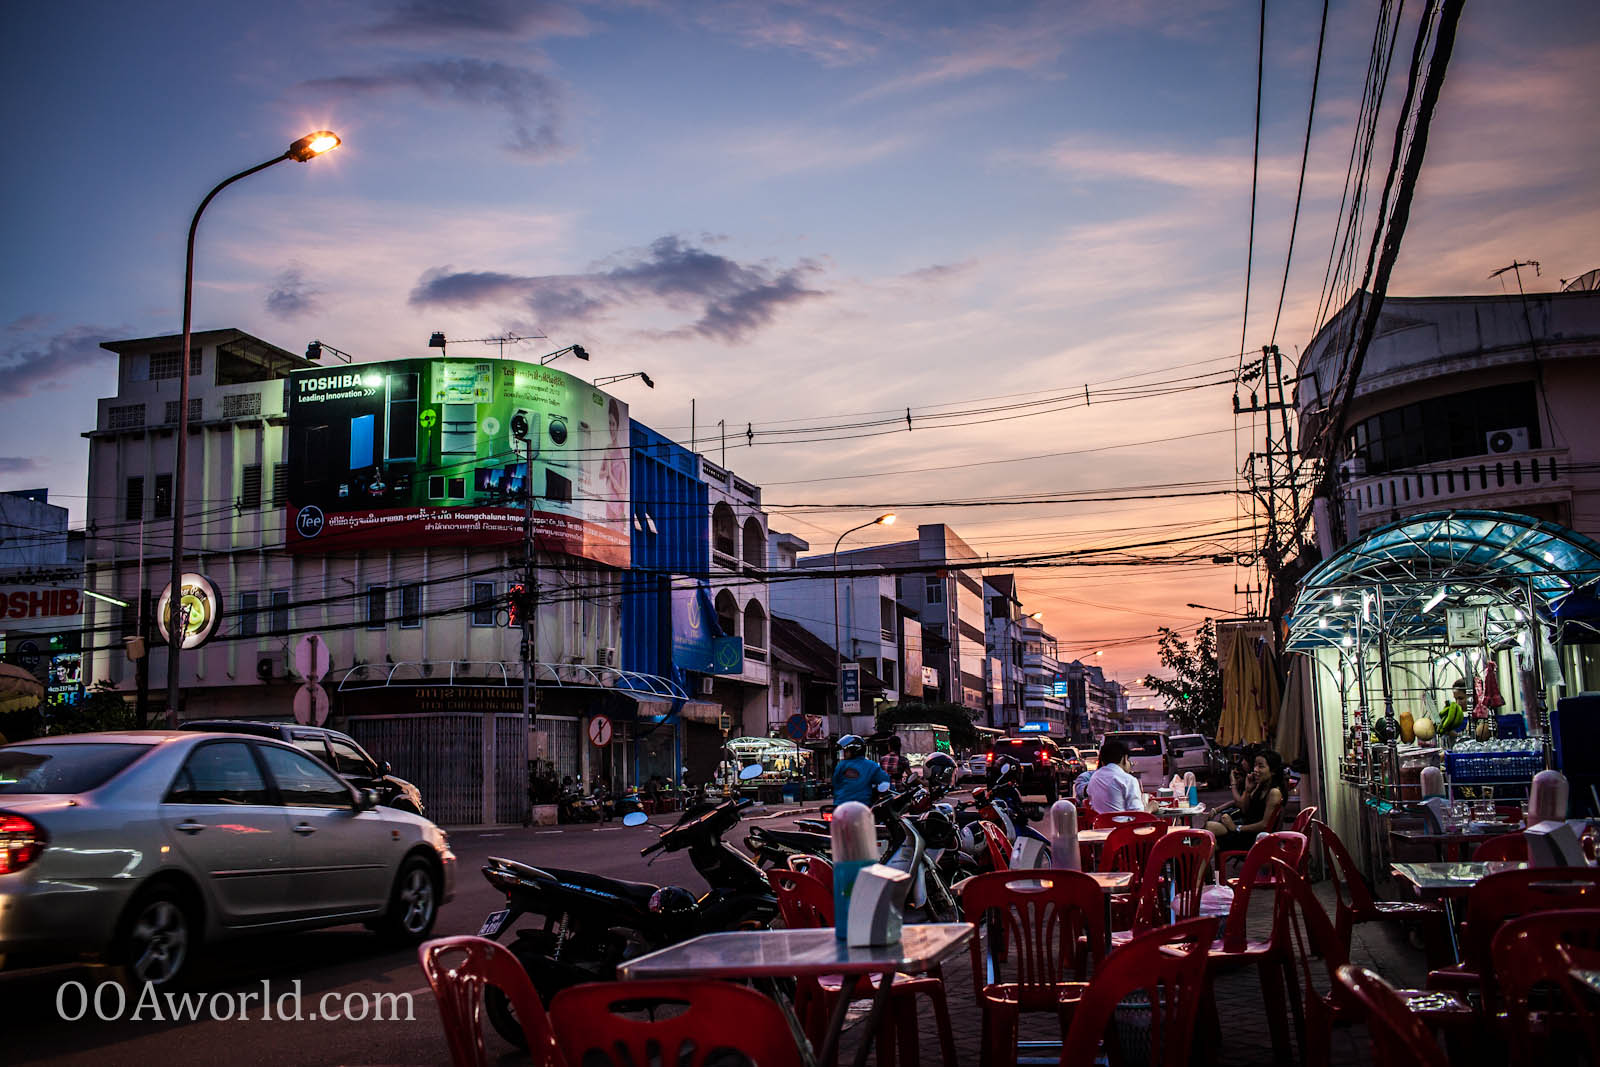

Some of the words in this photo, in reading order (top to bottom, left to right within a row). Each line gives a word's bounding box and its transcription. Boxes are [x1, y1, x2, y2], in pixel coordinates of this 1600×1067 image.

[298, 374, 362, 392] TOSHIBA
[298, 394, 325, 403] Leading
[326, 390, 362, 400] Innovation
[300, 513, 322, 528] Tee
[455, 513, 506, 521] Houngchalune
[0, 588, 83, 619] SHIB
